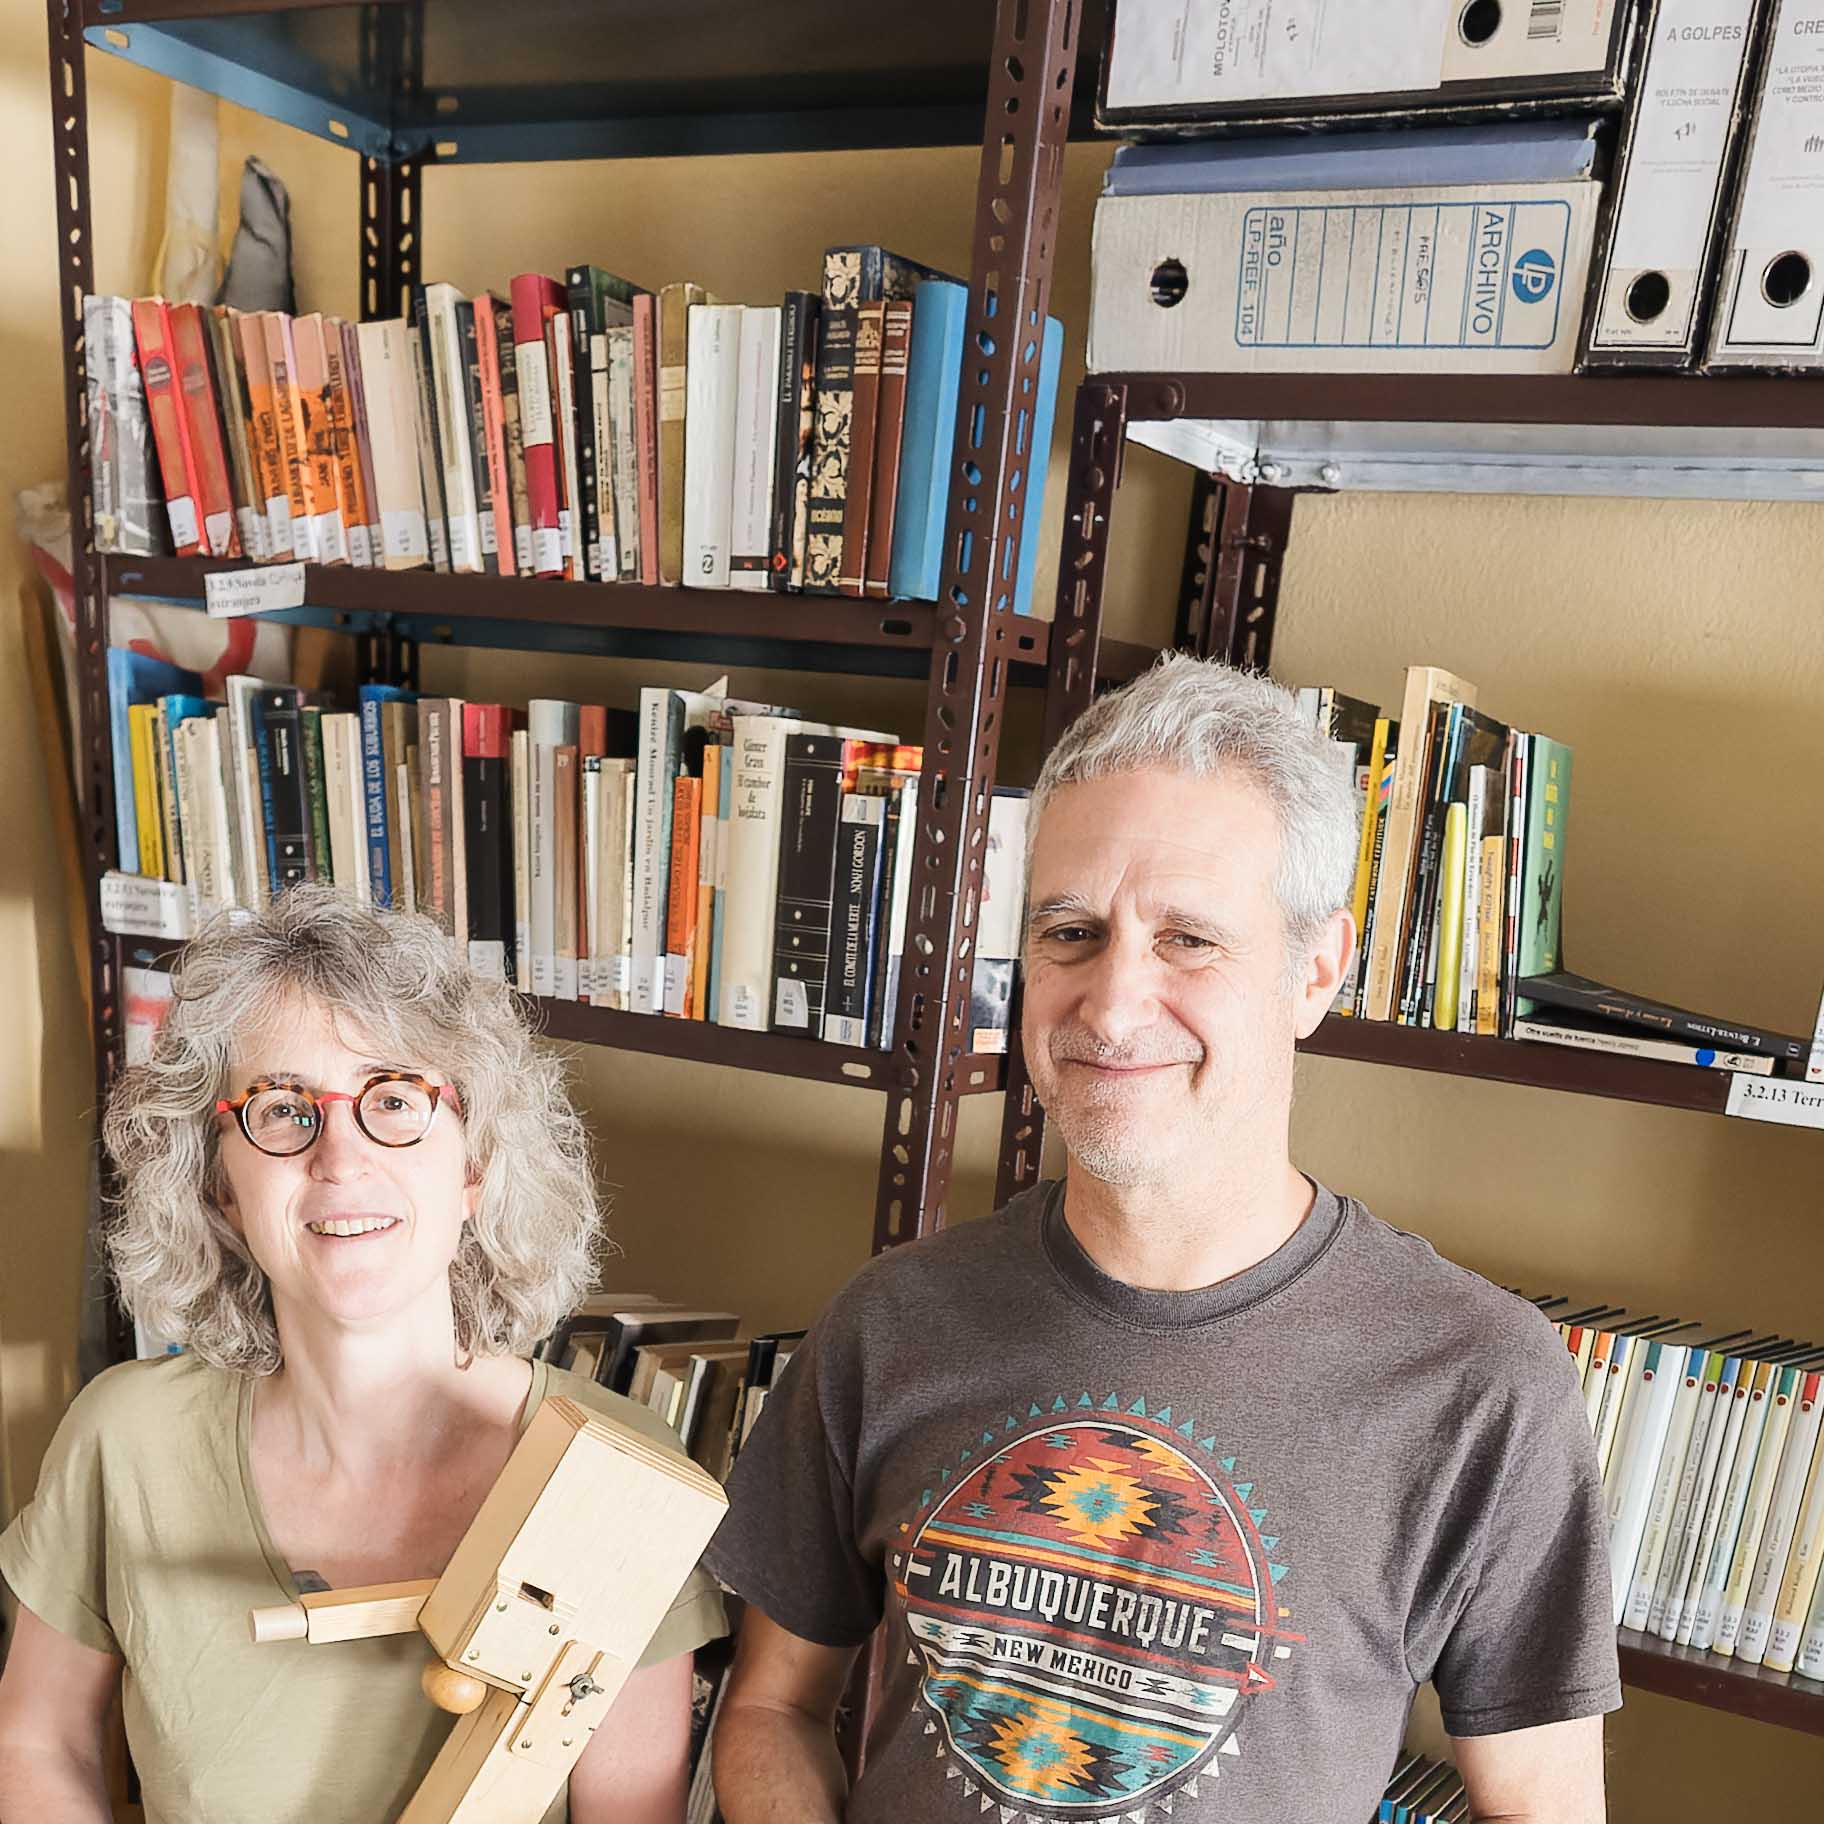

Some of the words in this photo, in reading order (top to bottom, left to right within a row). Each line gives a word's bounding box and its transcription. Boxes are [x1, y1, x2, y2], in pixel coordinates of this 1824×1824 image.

[1667, 26, 1677, 41] A
[1680, 25, 1742, 41] GOLPES
[1267, 216, 1286, 267] año
[1472, 210, 1505, 335] ARCHIVO
[743, 753, 764, 770] Grass
[852, 829, 867, 868] GORDON
[850, 867, 863, 895] NOAH
[1743, 1083, 1788, 1103] 3.2.13
[938, 1553, 1216, 1655] ALBUQUERQUE
[992, 1637, 1044, 1661] NEW
[1049, 1655, 1132, 1690] MEXICO
